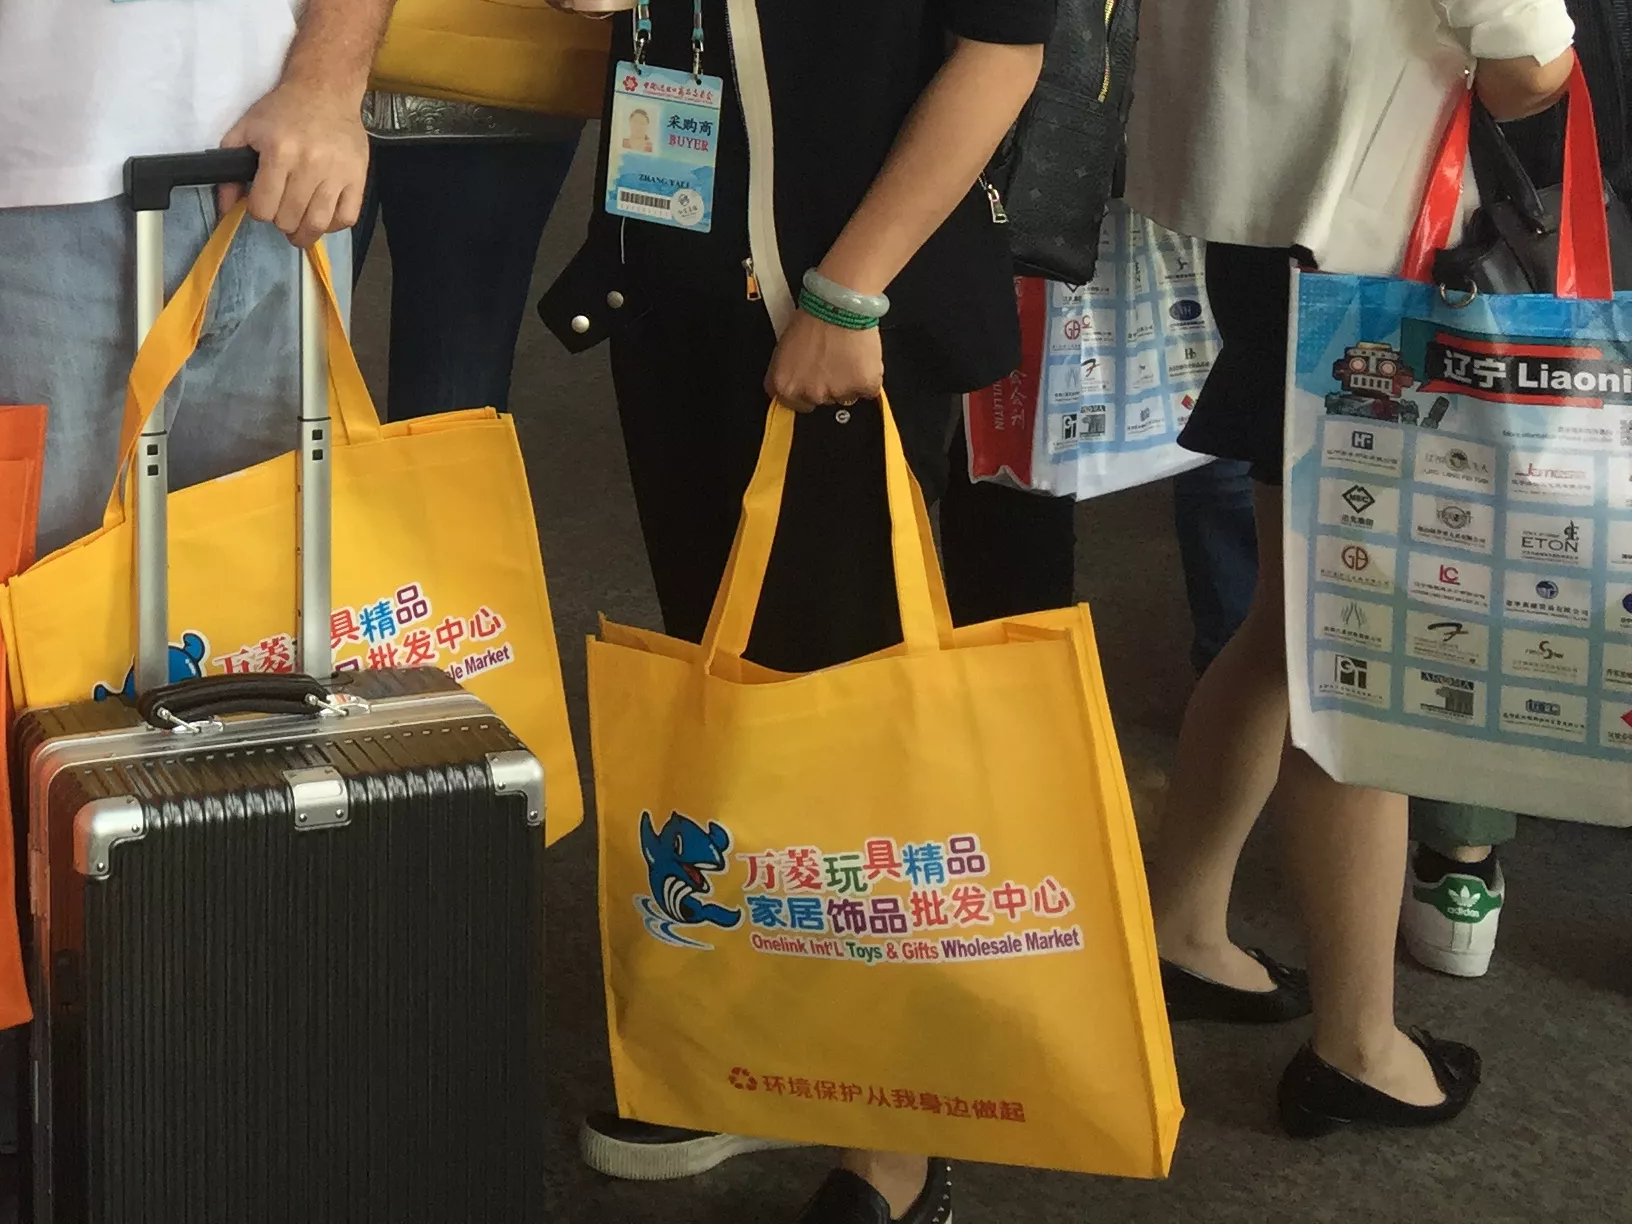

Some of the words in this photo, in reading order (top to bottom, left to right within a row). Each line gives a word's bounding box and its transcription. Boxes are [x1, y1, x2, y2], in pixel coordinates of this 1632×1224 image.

[667, 114, 714, 137] 采购商
[669, 134, 709, 152] BUYER
[1443, 349, 1507, 389] 辽宁
[1521, 536, 1579, 553] ETON
[215, 583, 429, 674] 万菱具精品
[465, 645, 510, 676] Market
[744, 835, 986, 894] 万菱玩具精品
[746, 877, 1070, 935] 家居饰品批发中心
[751, 933, 807, 956] Onelink
[845, 941, 883, 964] Toys
[886, 943, 899, 960] &
[902, 941, 939, 960] Gifts
[941, 934, 1022, 959] Wholesale
[1025, 928, 1080, 952] Market
